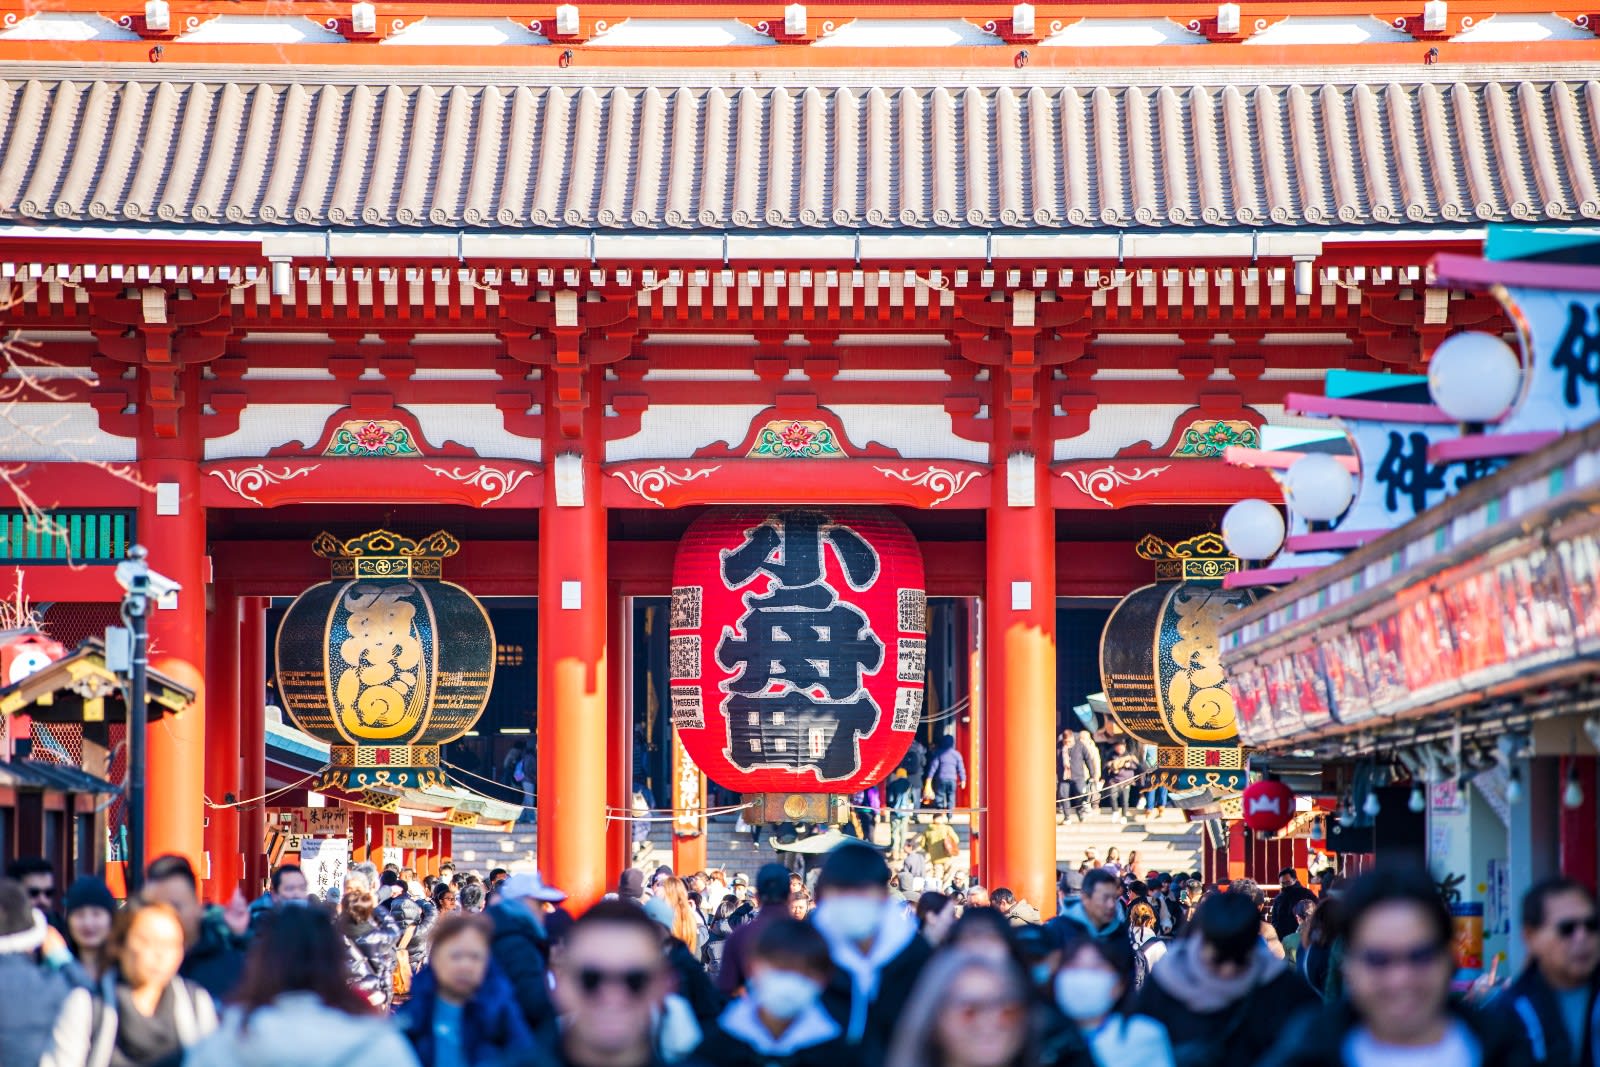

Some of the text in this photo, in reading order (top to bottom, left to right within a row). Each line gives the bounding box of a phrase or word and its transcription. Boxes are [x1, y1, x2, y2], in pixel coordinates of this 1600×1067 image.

[714, 507, 885, 782] 小舟町
[310, 808, 346, 824] 朱印所
[397, 829, 430, 841] 朱印所
